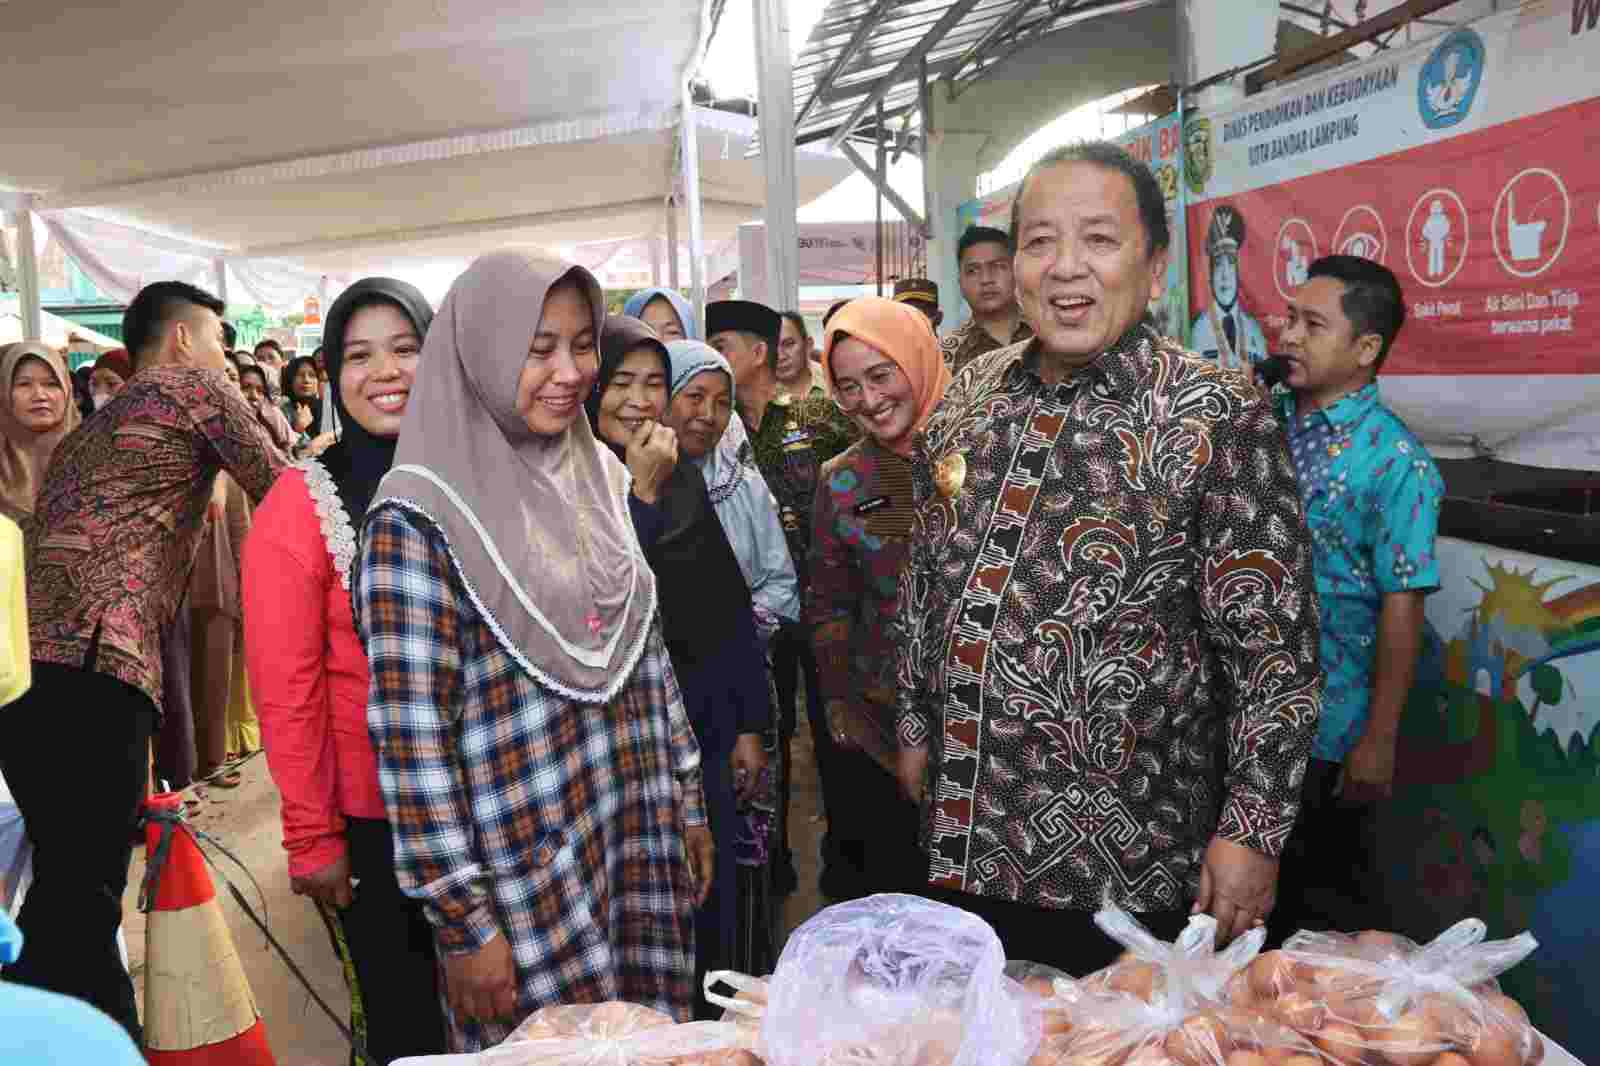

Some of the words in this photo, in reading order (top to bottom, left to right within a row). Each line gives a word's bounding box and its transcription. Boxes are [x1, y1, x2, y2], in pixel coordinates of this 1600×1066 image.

[1304, 89, 1326, 116] DAN
[1327, 64, 1400, 108] KEBUDAYAAN
[1270, 129, 1309, 160] BANDAR
[1310, 113, 1359, 149] LAMPUNG
